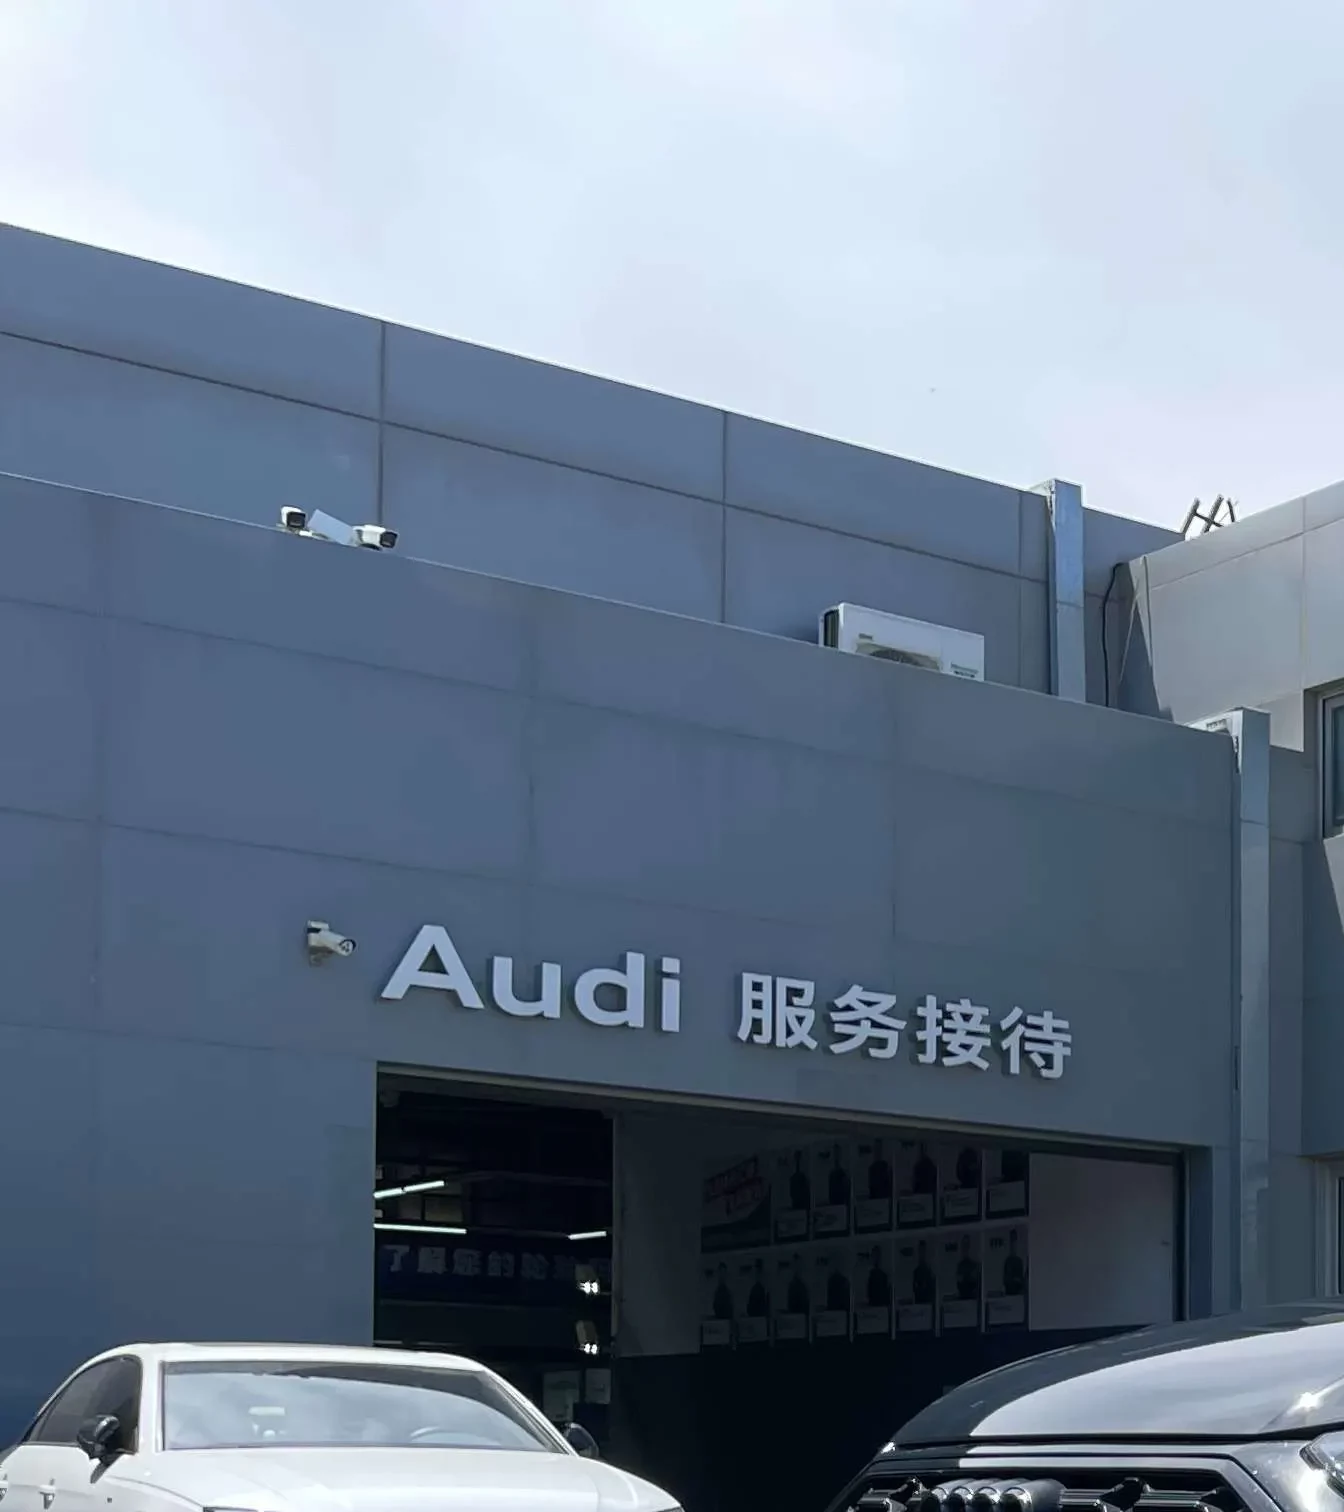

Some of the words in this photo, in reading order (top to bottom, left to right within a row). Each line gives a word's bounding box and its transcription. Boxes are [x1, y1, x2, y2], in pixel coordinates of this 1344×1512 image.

[381, 924, 681, 1034] Audi
[737, 971, 1073, 1080] 服务接待
